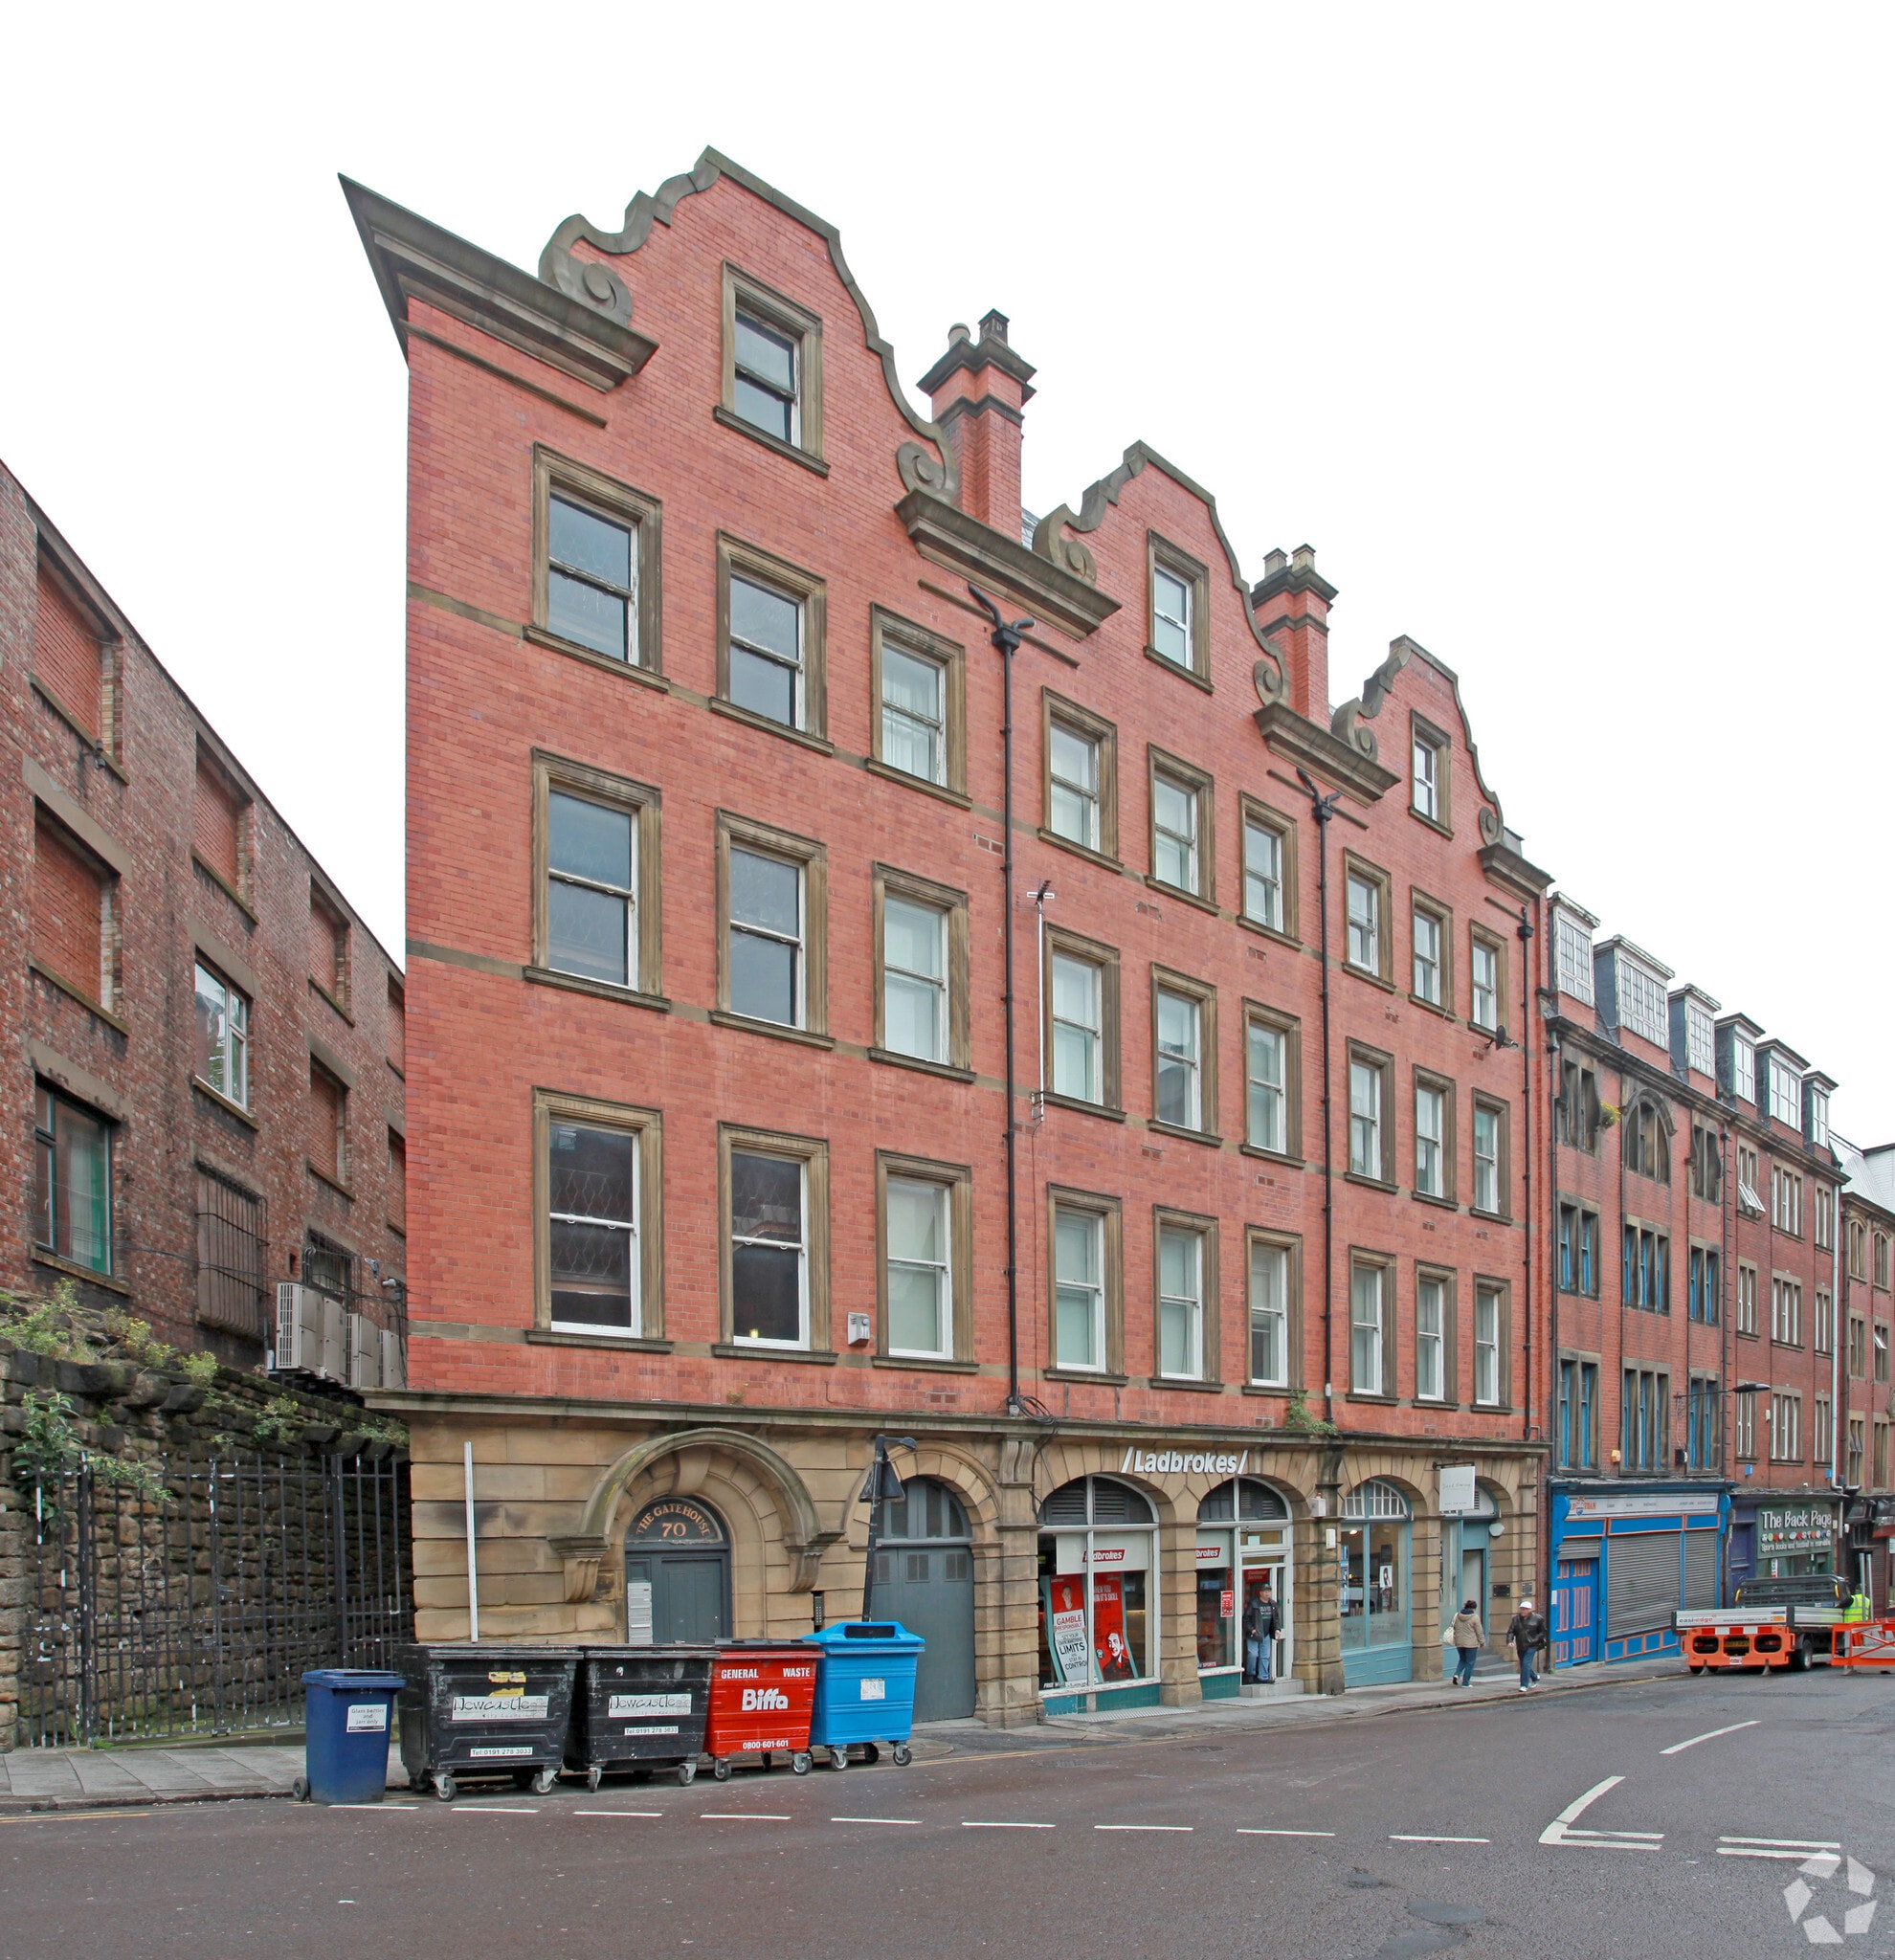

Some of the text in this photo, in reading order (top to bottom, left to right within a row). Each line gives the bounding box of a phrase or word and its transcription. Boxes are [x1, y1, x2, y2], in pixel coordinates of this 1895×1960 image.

[635, 1503, 710, 1536] THE GATEHOUSE
[1762, 1510, 1831, 1528] The Back Page
[661, 1523, 687, 1537] 70
[1057, 1615, 1081, 1625] GAMBLE
[1059, 1641, 1085, 1655] LIMITS
[1064, 1660, 1087, 1670] CONTRO
[721, 1667, 811, 1679] GENERAL WASTE
[453, 1696, 530, 1711] Newcastle
[609, 1695, 676, 1709] Newcastle
[742, 1688, 789, 1711] Biffa
